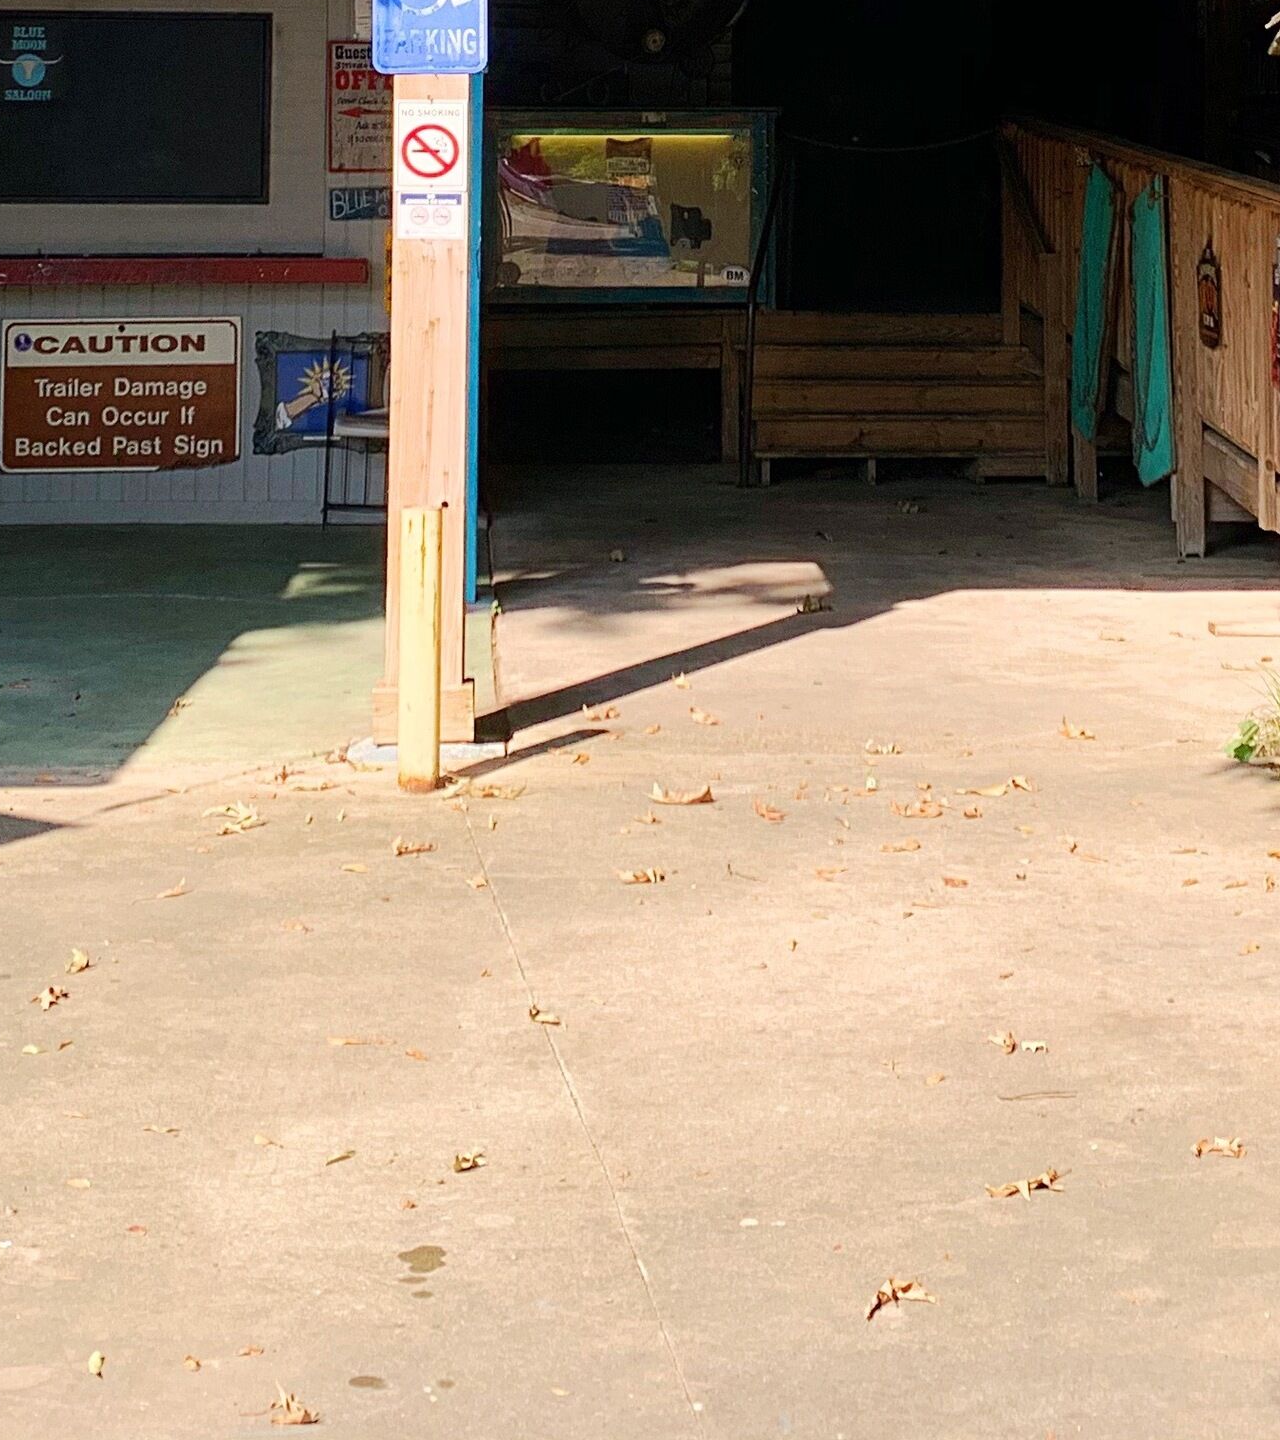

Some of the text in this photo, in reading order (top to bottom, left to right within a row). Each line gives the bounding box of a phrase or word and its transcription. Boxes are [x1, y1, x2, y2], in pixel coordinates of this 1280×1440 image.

[13, 26, 45, 38] BLUE
[11, 39, 47, 51] MOON
[4, 89, 51, 101] SALOON
[401, 109, 460, 117] NO SMOKING
[33, 334, 206, 354] CAUTION
[34, 377, 207, 400] Trailer Damage
[46, 405, 196, 426] Can Occur If
[15, 434, 224, 459] Backed Past Sign
